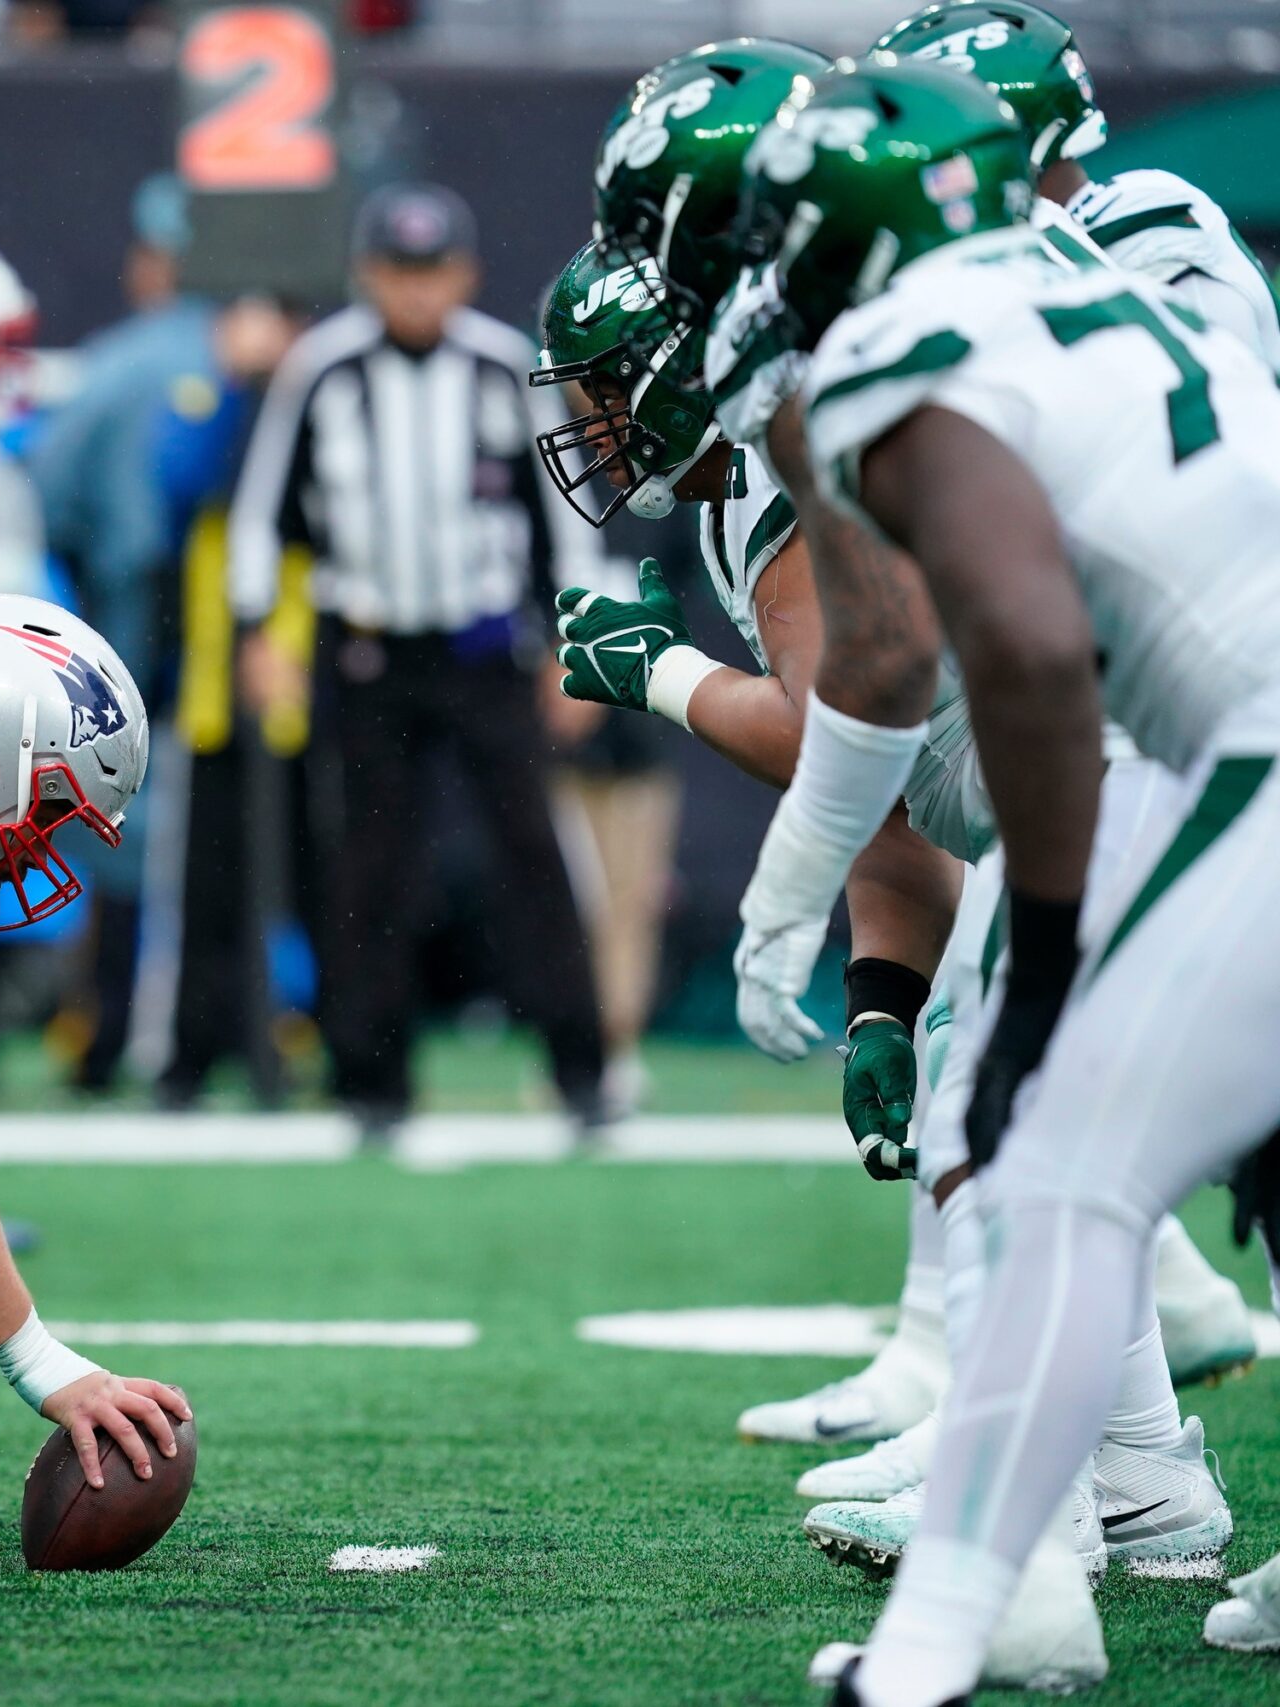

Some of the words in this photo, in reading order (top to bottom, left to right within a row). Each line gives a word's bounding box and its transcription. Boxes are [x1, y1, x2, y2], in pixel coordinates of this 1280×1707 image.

[182, 7, 333, 188] 2
[910, 21, 1010, 64] ETS
[572, 256, 666, 324] JET
[1038, 291, 1221, 465] 7
